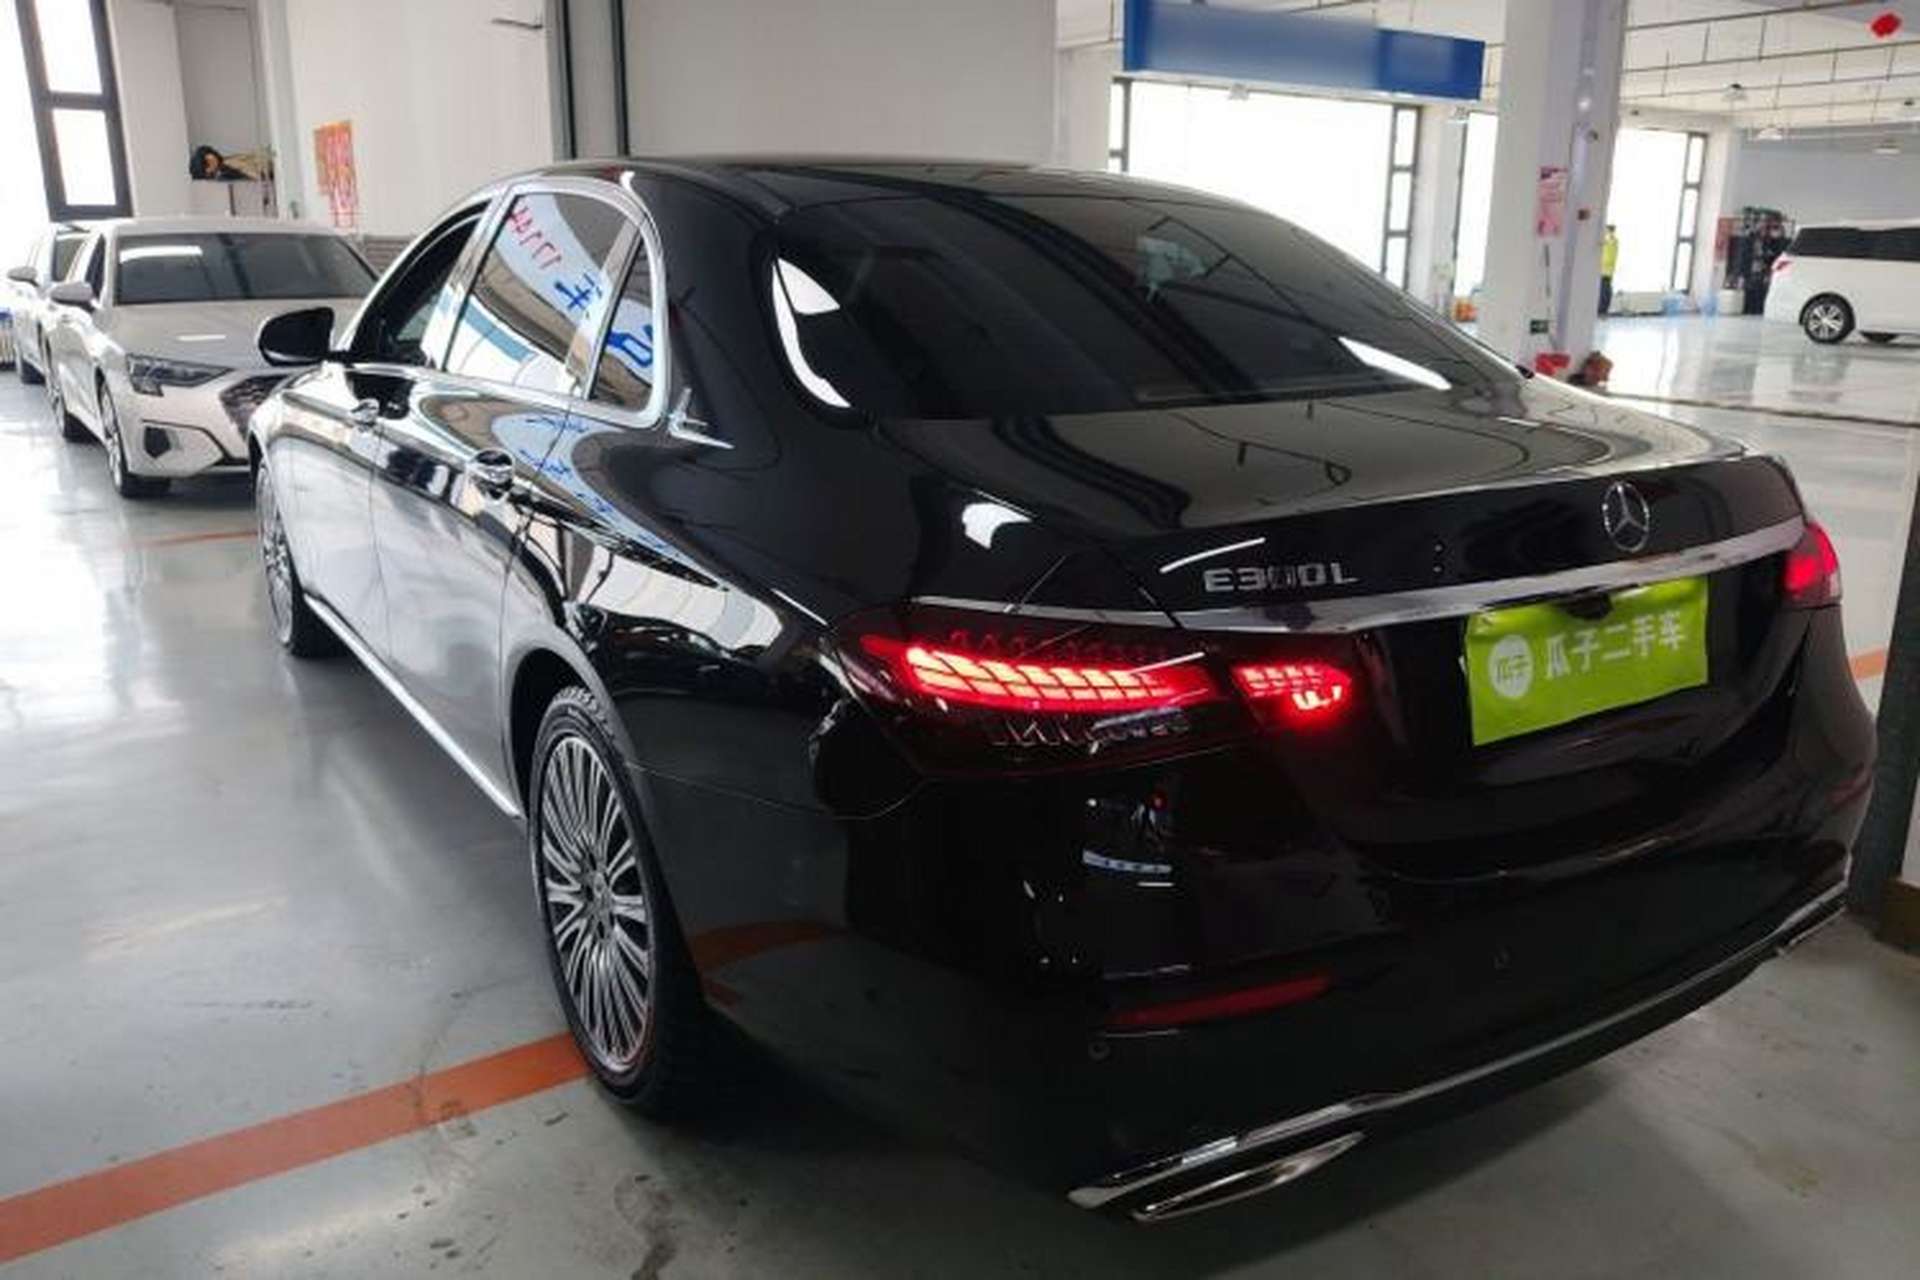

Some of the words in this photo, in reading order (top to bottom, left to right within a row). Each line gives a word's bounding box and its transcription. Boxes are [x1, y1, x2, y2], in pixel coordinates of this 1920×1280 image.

[1203, 562, 1359, 592] E300L
[1546, 610, 1685, 680] 瓜子二手车
